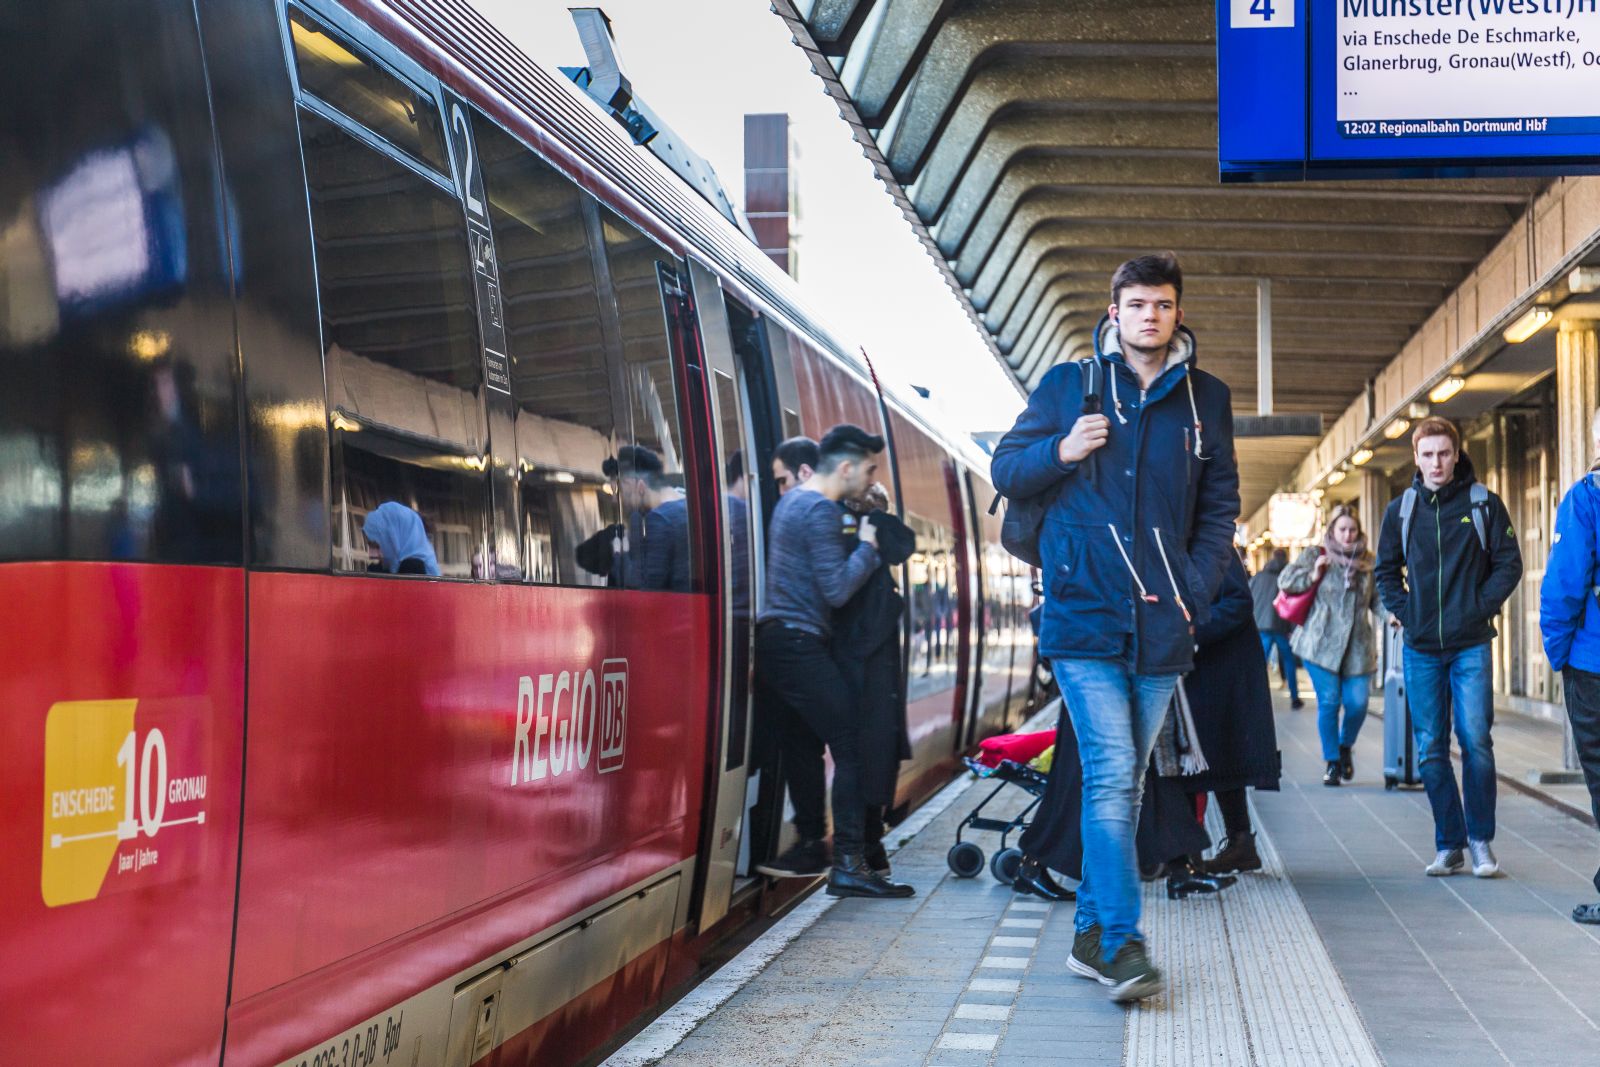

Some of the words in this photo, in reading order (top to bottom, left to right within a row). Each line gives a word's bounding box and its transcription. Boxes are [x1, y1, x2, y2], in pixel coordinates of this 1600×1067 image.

[1249, 0, 1275, 21] 4
[1343, 30, 1367, 46] via
[1374, 28, 1451, 45] Enschede
[1458, 29, 1479, 44] De
[1486, 26, 1580, 44] Eschmarke,
[1343, 54, 1442, 74] Glanerbrug,
[1448, 50, 1575, 71] Gronau(Westf),
[1343, 121, 1376, 135] 12:02
[1379, 120, 1460, 137] Regionalbahn
[1463, 118, 1522, 133] Dortmund
[1525, 118, 1548, 132] Hbf
[452, 103, 483, 217] 2
[511, 668, 596, 787] REGIO
[600, 671, 627, 759] DB
[117, 728, 167, 840] 10
[169, 775, 207, 804] GRONAU
[51, 786, 115, 819] ENSCHEDE
